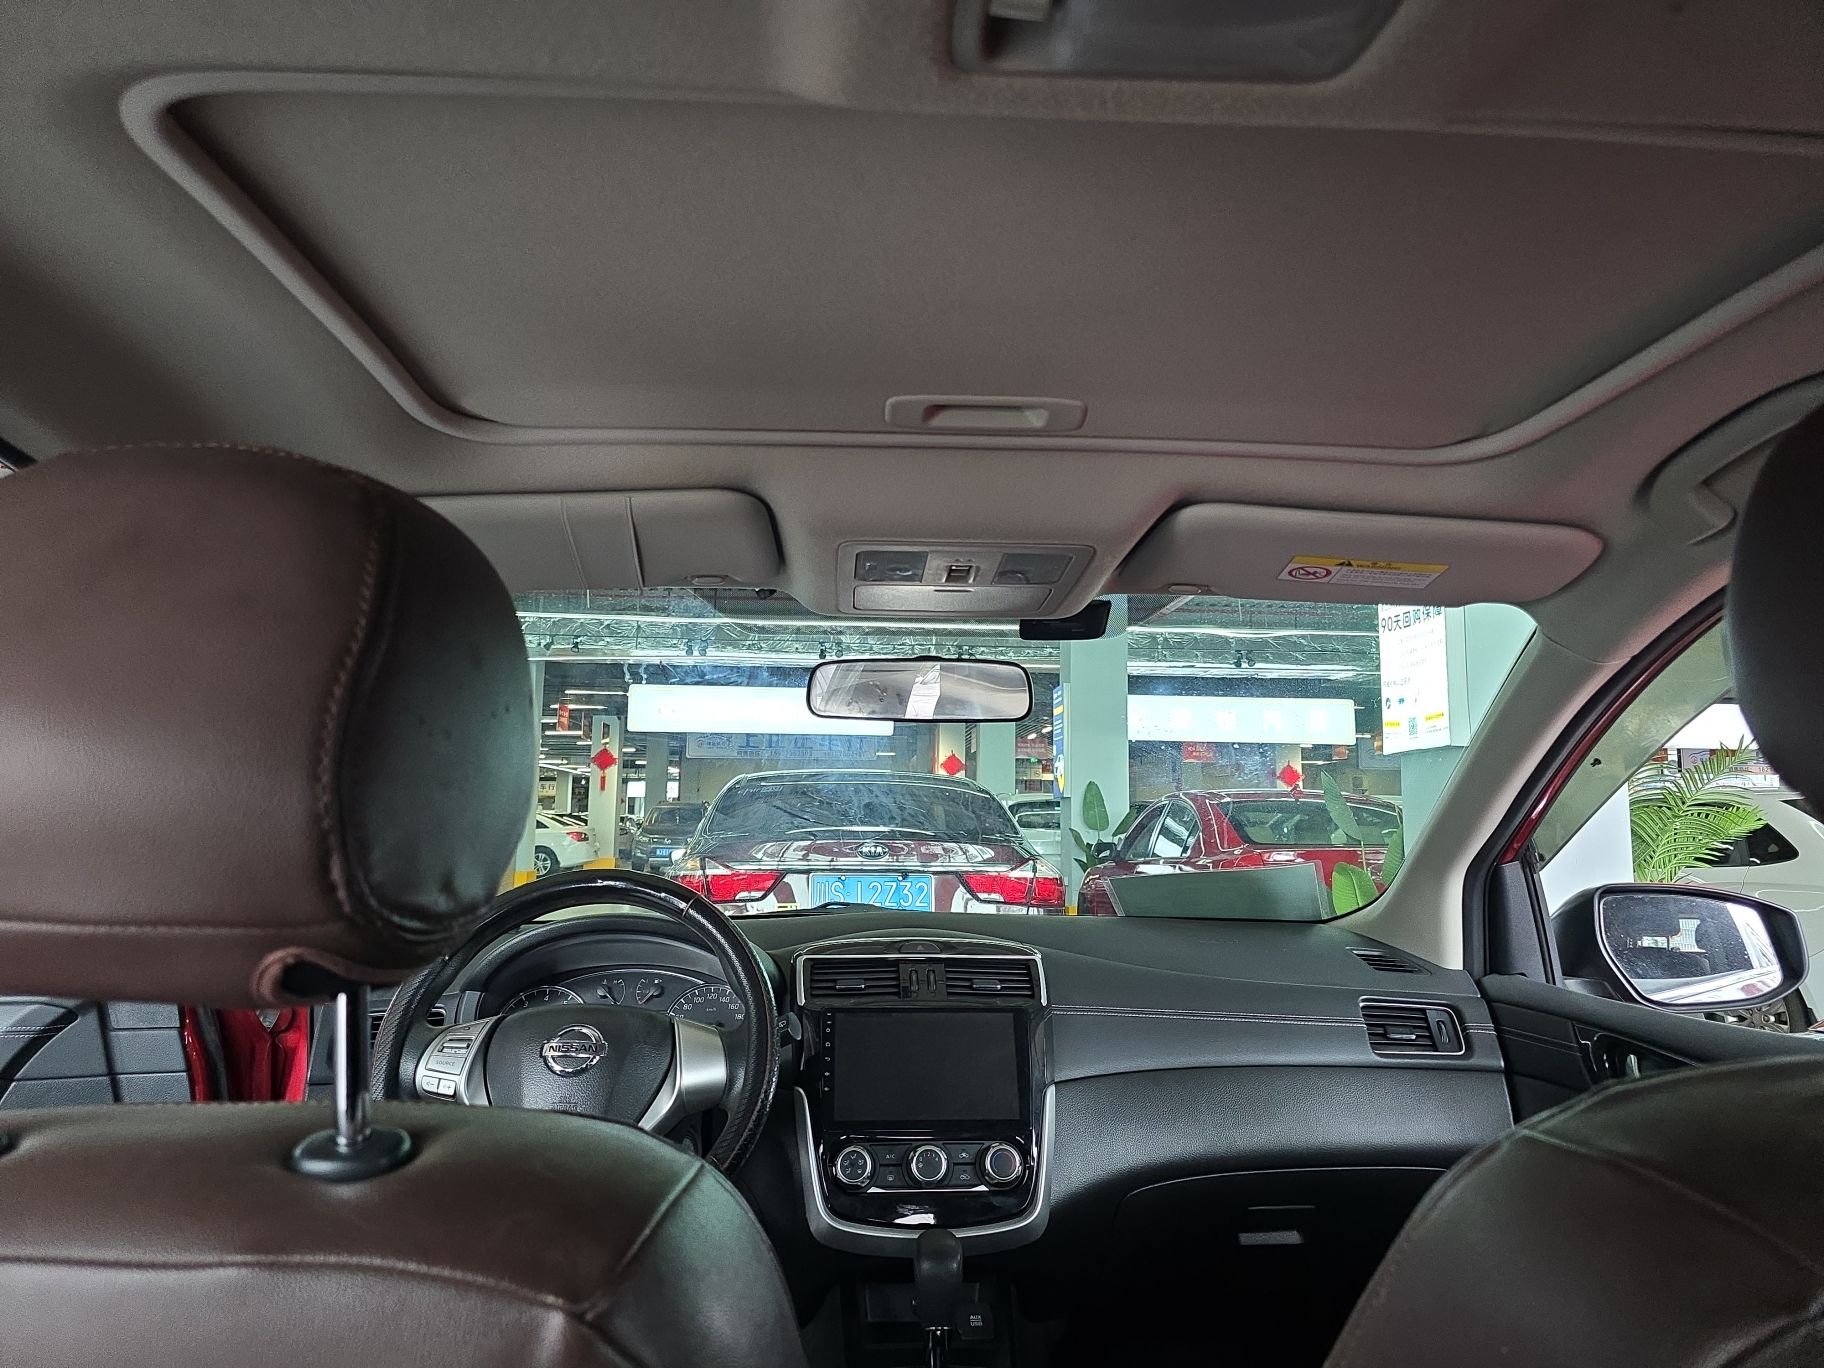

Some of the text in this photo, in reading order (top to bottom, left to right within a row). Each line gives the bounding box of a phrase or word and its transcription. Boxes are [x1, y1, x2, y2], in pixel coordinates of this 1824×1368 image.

[862, 846, 884, 856] KIA
[549, 1044, 598, 1053] NISSAN
[435, 1059, 455, 1067] SOURCE
